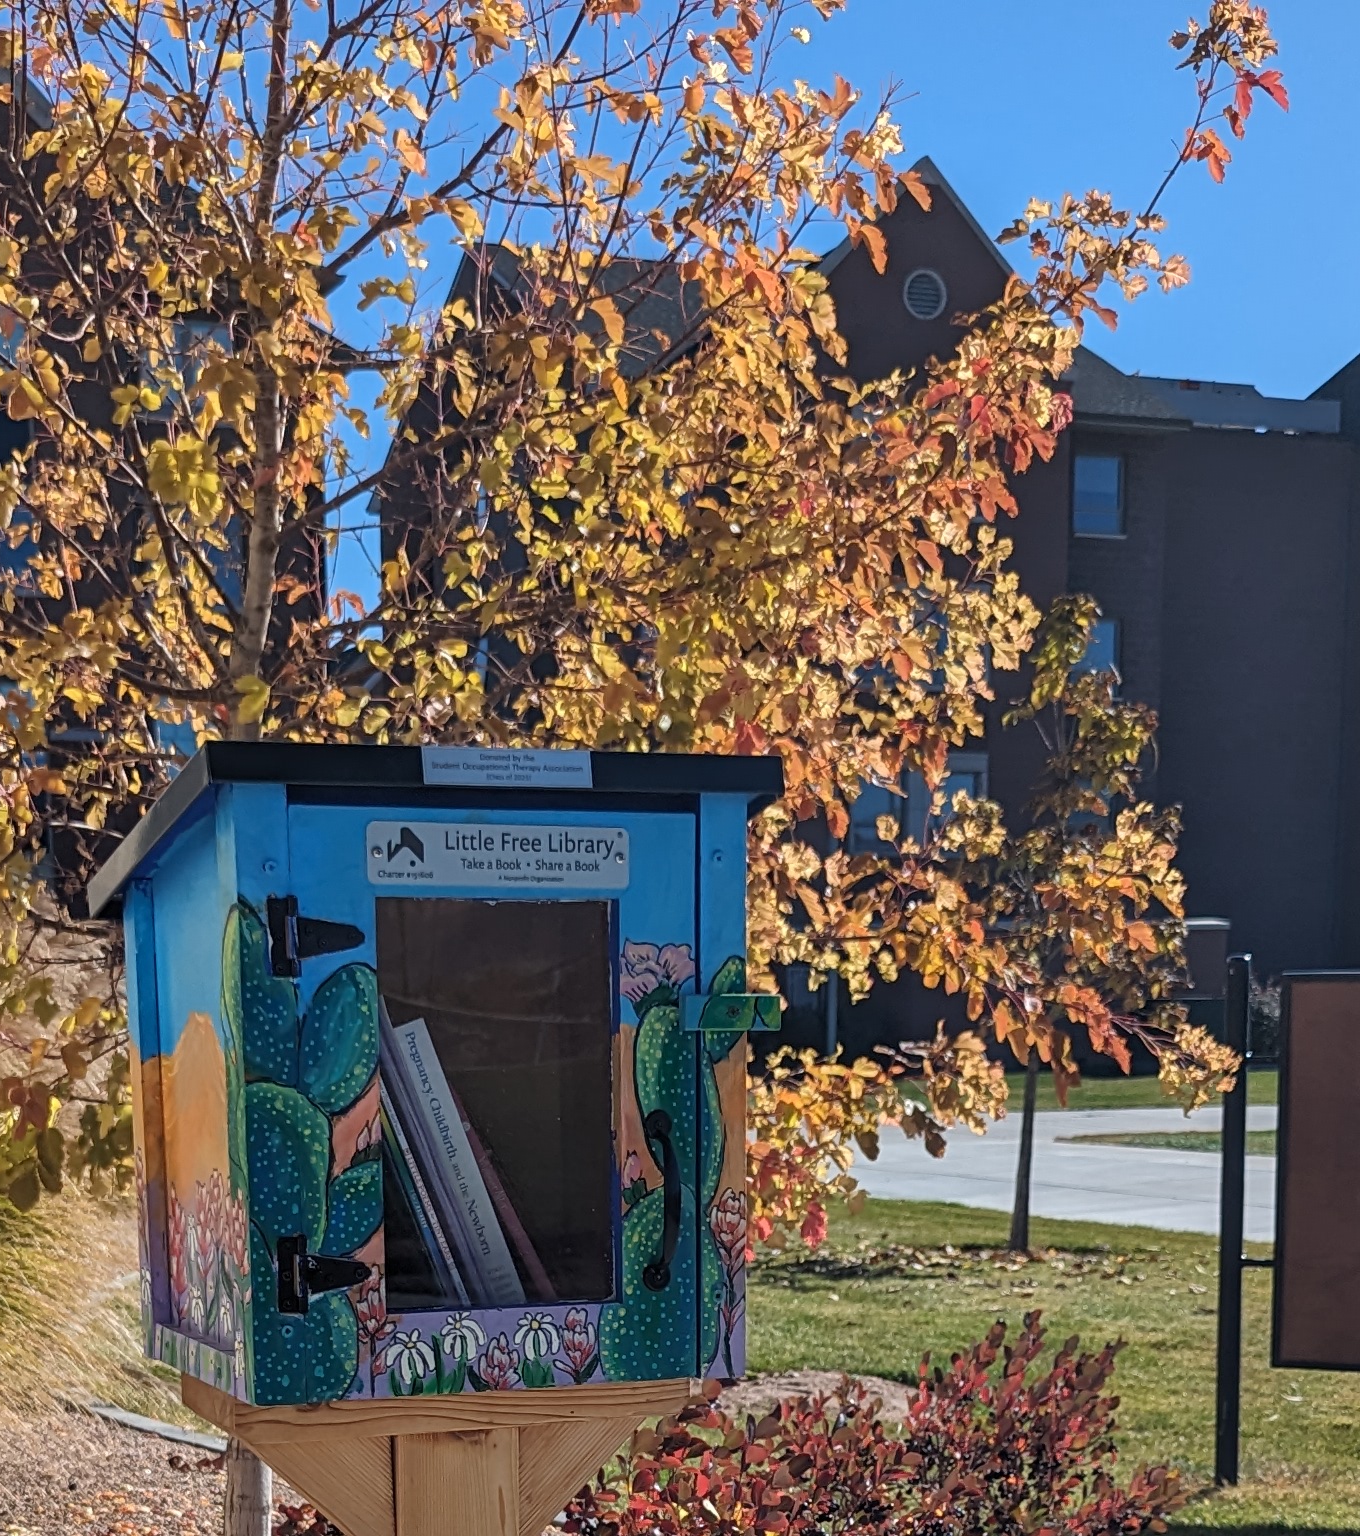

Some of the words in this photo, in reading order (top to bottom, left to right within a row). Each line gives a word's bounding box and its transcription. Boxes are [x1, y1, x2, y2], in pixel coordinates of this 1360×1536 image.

[512, 754, 521, 763] by
[523, 754, 536, 762] the
[462, 762, 510, 772] Occupational
[512, 763, 540, 772] Therapy
[542, 764, 584, 773] Association
[444, 830, 494, 852] Little
[501, 832, 542, 853] Free
[461, 858, 484, 869] Take
[487, 861, 493, 870] a
[496, 859, 522, 870] Book
[535, 860, 564, 871] Share
[566, 863, 572, 871] a
[575, 860, 600, 872] Book
[377, 870, 405, 879] Charter
[452, 1162, 464, 1179] and
[457, 1178, 470, 1200] the
[465, 1200, 492, 1256] Newborn
